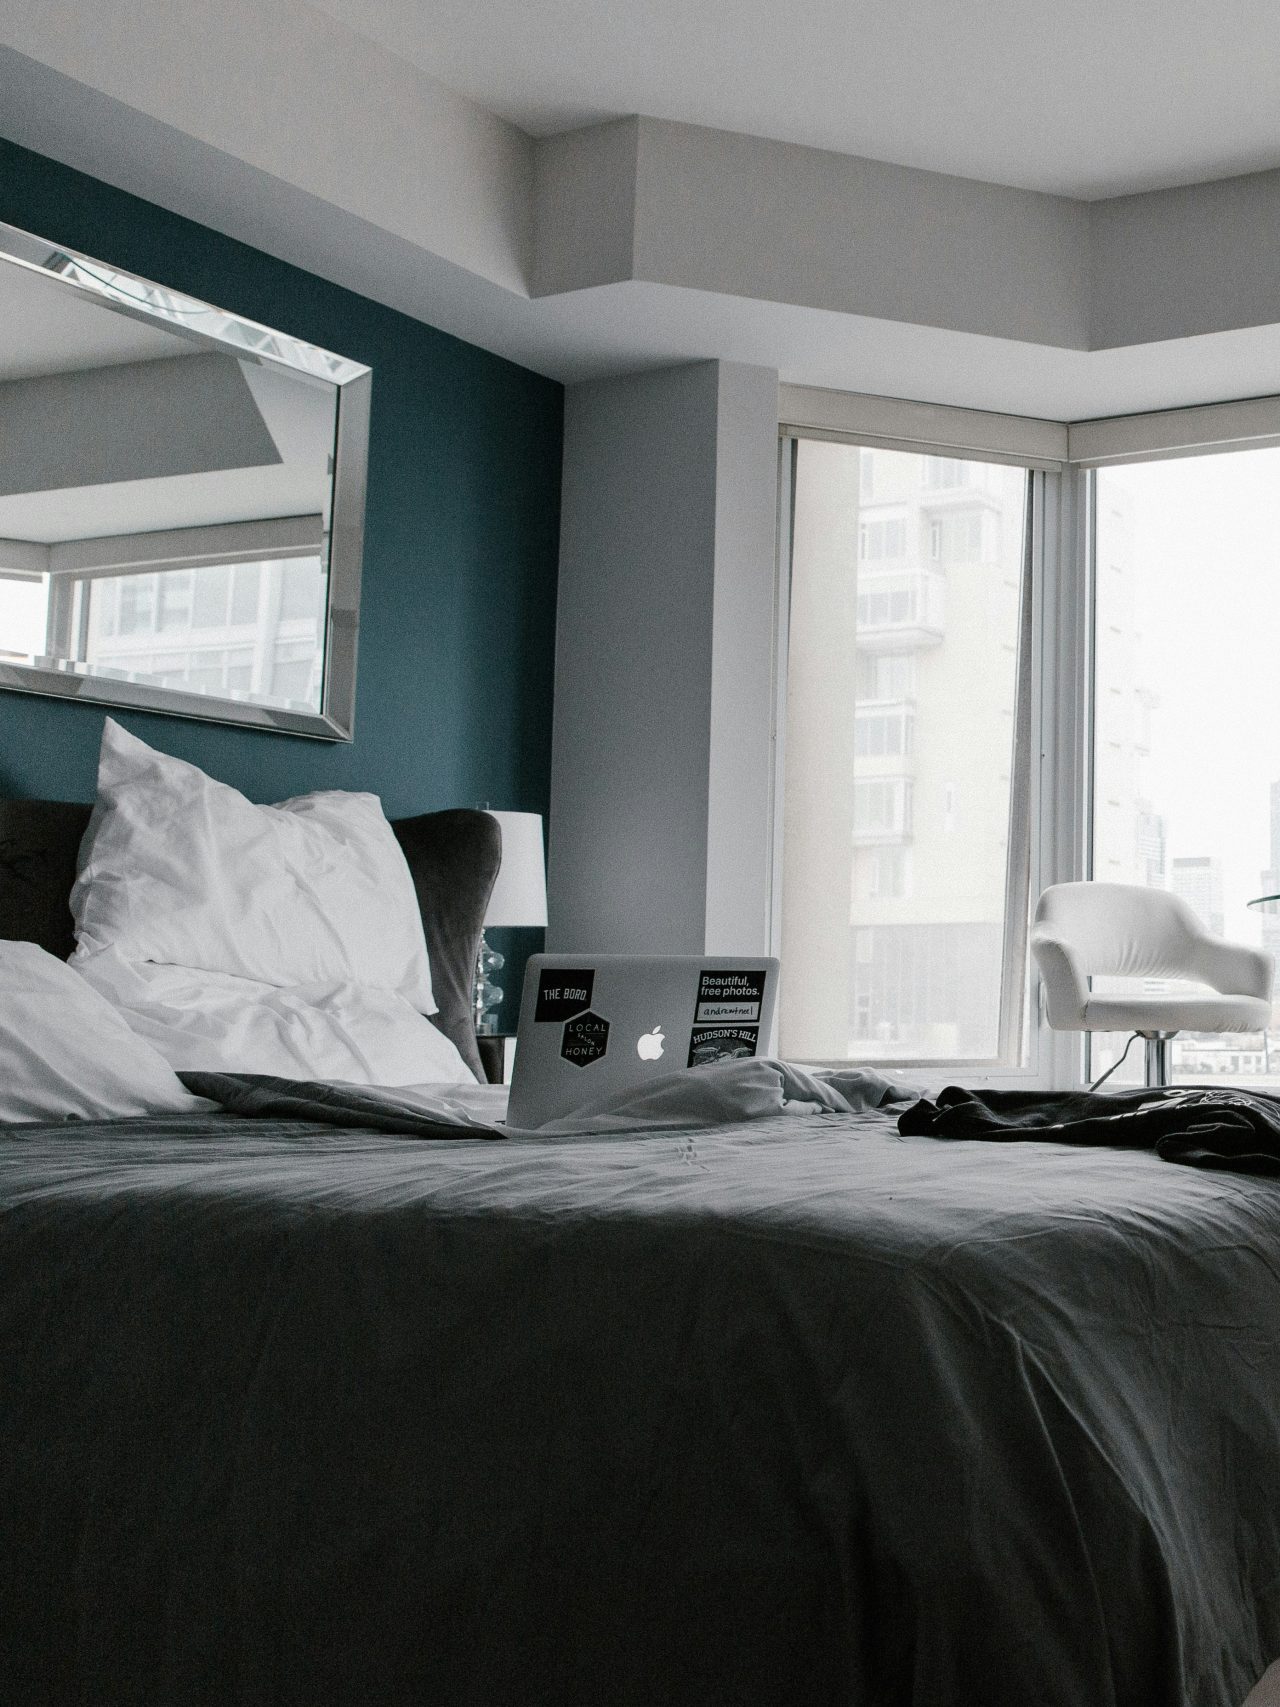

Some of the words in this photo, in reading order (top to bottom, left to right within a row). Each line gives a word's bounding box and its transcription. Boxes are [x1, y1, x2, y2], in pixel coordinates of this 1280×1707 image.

[702, 976, 749, 986] Beautiful,
[543, 988, 560, 1000] THE
[701, 986, 720, 996] free
[722, 986, 760, 997] photos.
[568, 1023, 606, 1032] LOCAL
[577, 1033, 595, 1046] SALON
[693, 1029, 738, 1043] HUDSON'S
[738, 1030, 757, 1042] HILL
[565, 1046, 602, 1056] HONEY
